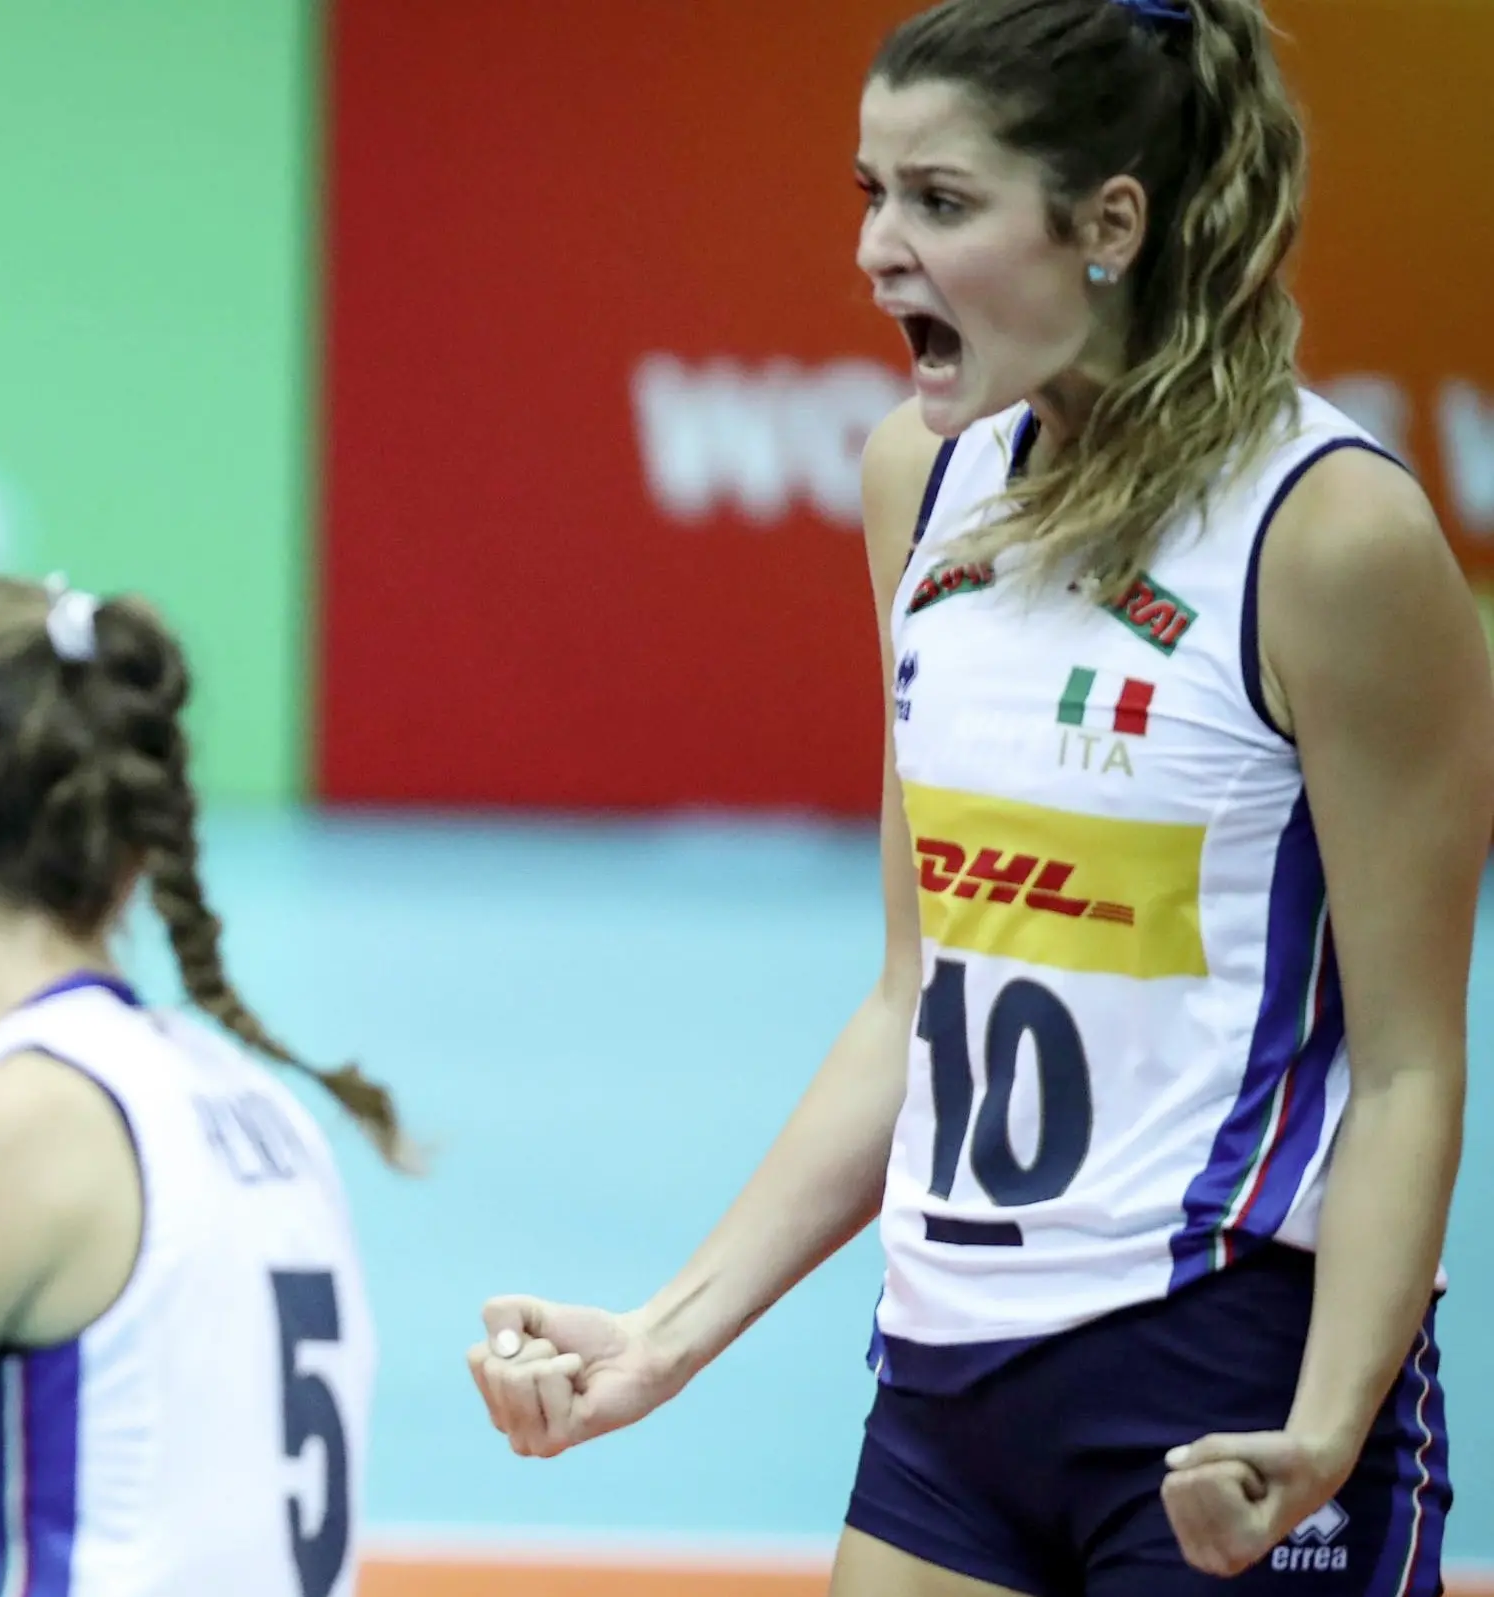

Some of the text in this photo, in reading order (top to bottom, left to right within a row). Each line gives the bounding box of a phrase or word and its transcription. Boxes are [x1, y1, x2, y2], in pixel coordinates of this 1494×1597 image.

[1058, 729, 1134, 777] ITA
[916, 836, 1091, 918] DHL
[917, 959, 1093, 1207] 10
[269, 1270, 350, 1597] 5
[1271, 1545, 1349, 1571] errea
